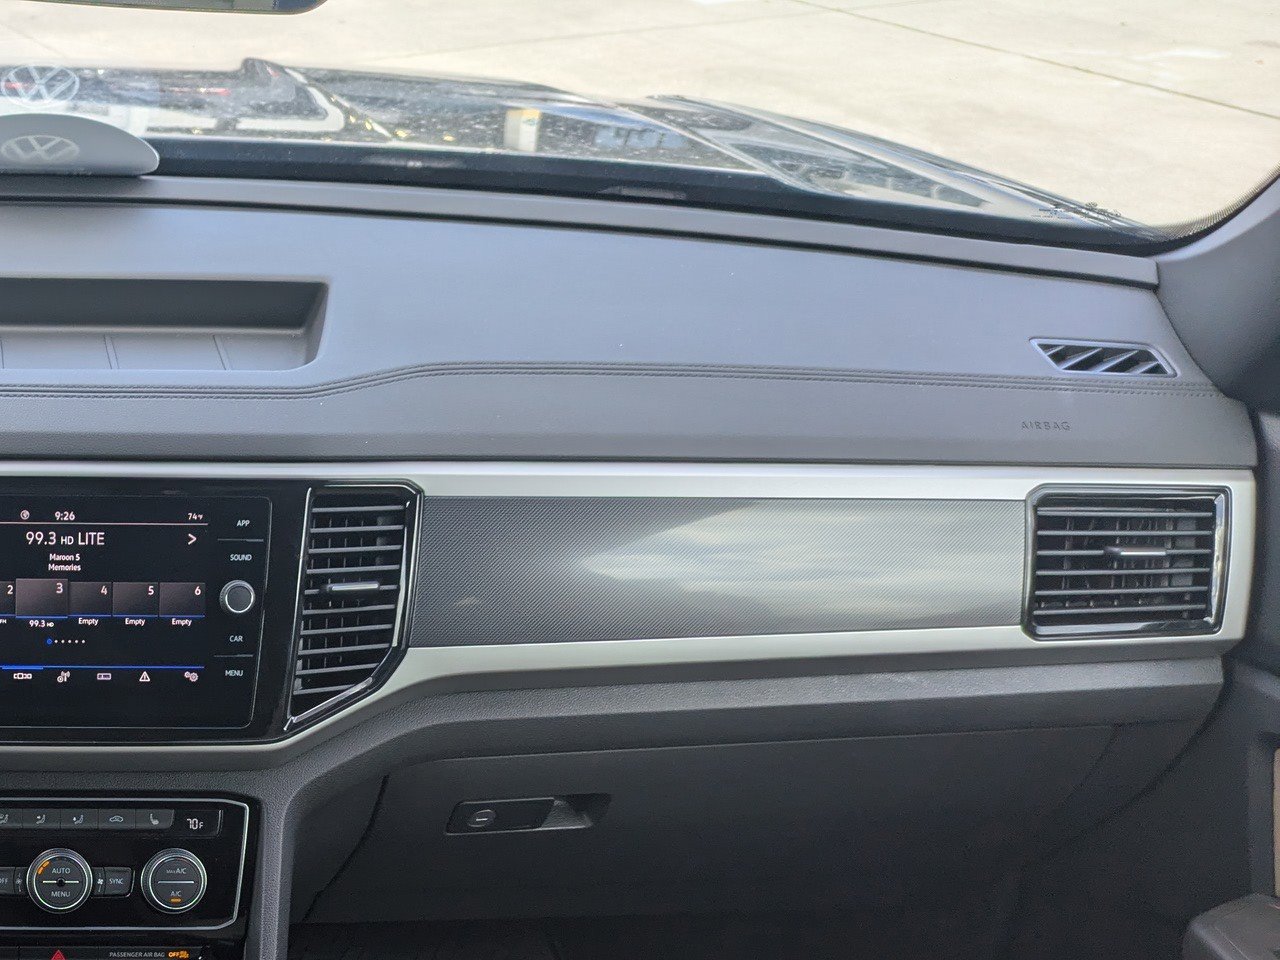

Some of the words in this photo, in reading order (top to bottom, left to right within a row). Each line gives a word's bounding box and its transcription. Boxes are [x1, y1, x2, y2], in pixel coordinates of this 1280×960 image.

[1020, 420, 1071, 431] AIRBAG
[54, 511, 76, 521] 9:26
[236, 519, 251, 527] APP
[25, 531, 57, 545] 99.3
[60, 536, 74, 545] HD
[78, 532, 105, 545] LITE
[49, 553, 74, 561] Maroon
[75, 553, 81, 561] 5
[48, 563, 81, 571] Memories
[7, 584, 14, 595] 2
[56, 582, 63, 594] 3
[100, 585, 108, 595] 4
[148, 585, 155, 595] 5
[194, 585, 202, 596] 6
[29, 619, 46, 628] 99.3
[78, 617, 99, 626] Empty
[125, 617, 146, 626] Empty
[171, 618, 192, 626] Empty
[225, 669, 244, 677] MENU
